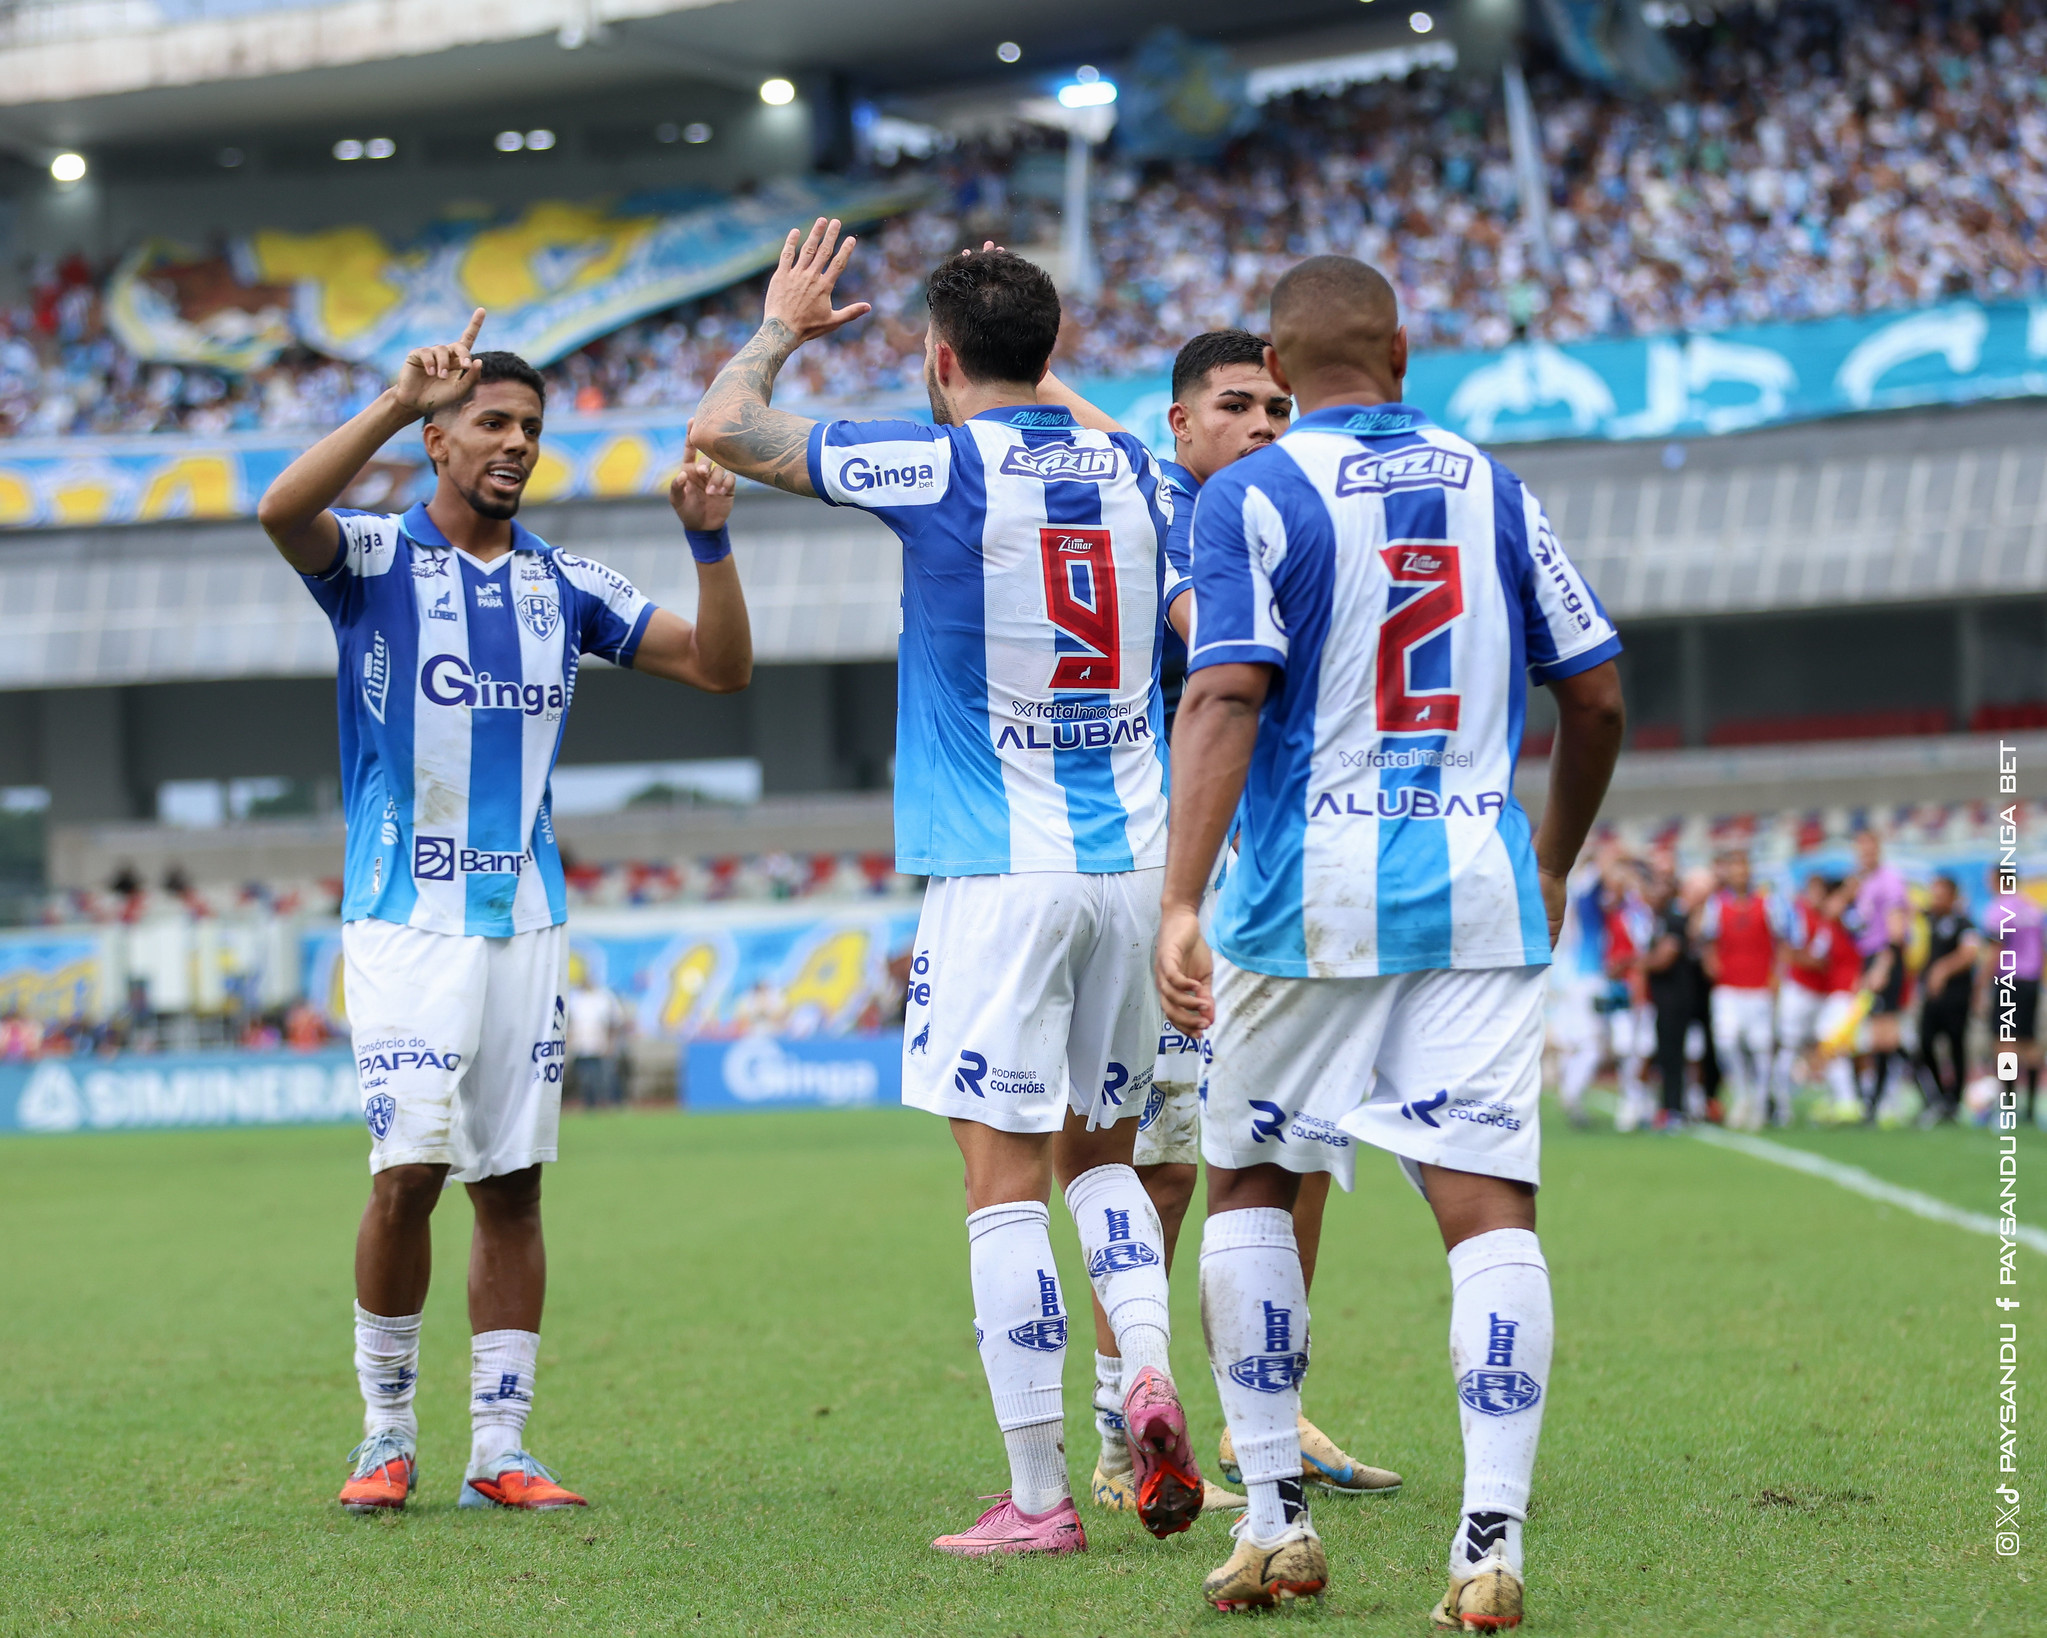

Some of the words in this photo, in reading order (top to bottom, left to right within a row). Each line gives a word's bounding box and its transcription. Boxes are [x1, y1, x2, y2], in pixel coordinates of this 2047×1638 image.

[839, 457, 933, 493] Ginga
[1056, 534, 1093, 554] Zilmar
[1535, 525, 1591, 632] Ginga
[1038, 527, 1121, 690] 9
[1375, 544, 1464, 732] 2
[420, 653, 564, 716] Ginga
[1036, 702, 1133, 720] fatalmodel
[996, 715, 1151, 750] ALUBAR
[1310, 790, 1505, 818] ALUBAR
[358, 1036, 406, 1055] Consórcio
[409, 1036, 427, 1048] do
[359, 1048, 462, 1078] PAPÃO
[992, 1067, 1037, 1080] RODRIGUES
[84, 1064, 360, 1132] SIMINERA
[990, 1080, 1046, 1094] COLCHÕES
[1448, 1107, 1522, 1132] COLCHÕES
[1291, 1124, 1350, 1148] COLCHÕES
